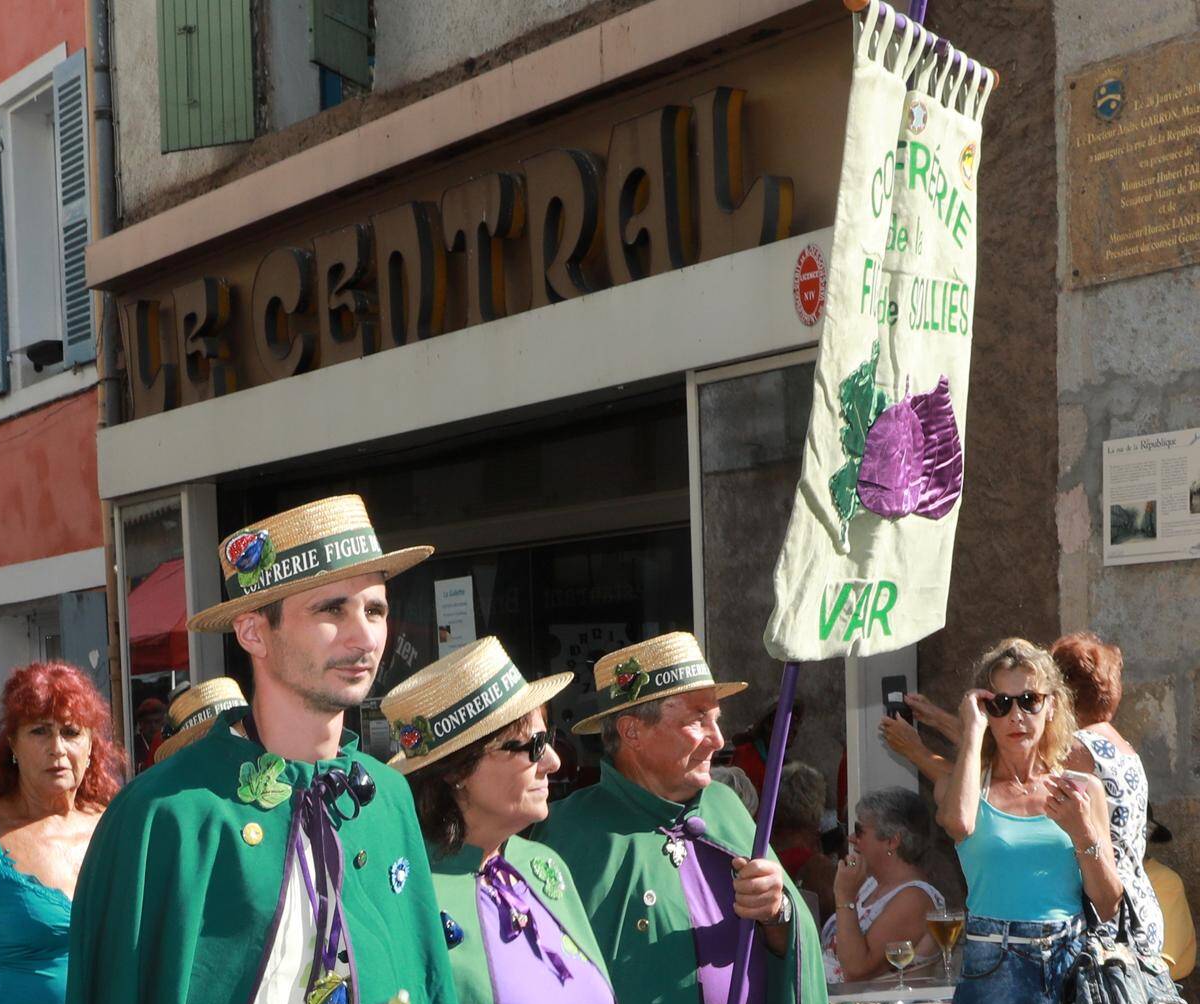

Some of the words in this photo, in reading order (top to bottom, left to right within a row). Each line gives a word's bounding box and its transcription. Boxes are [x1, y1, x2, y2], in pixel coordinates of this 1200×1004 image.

[120, 276, 237, 421] LE
[252, 87, 793, 380] CENTRAL
[325, 534, 368, 563] FIGUE
[818, 580, 898, 641] VAR
[433, 681, 503, 738] CONFRERIE
